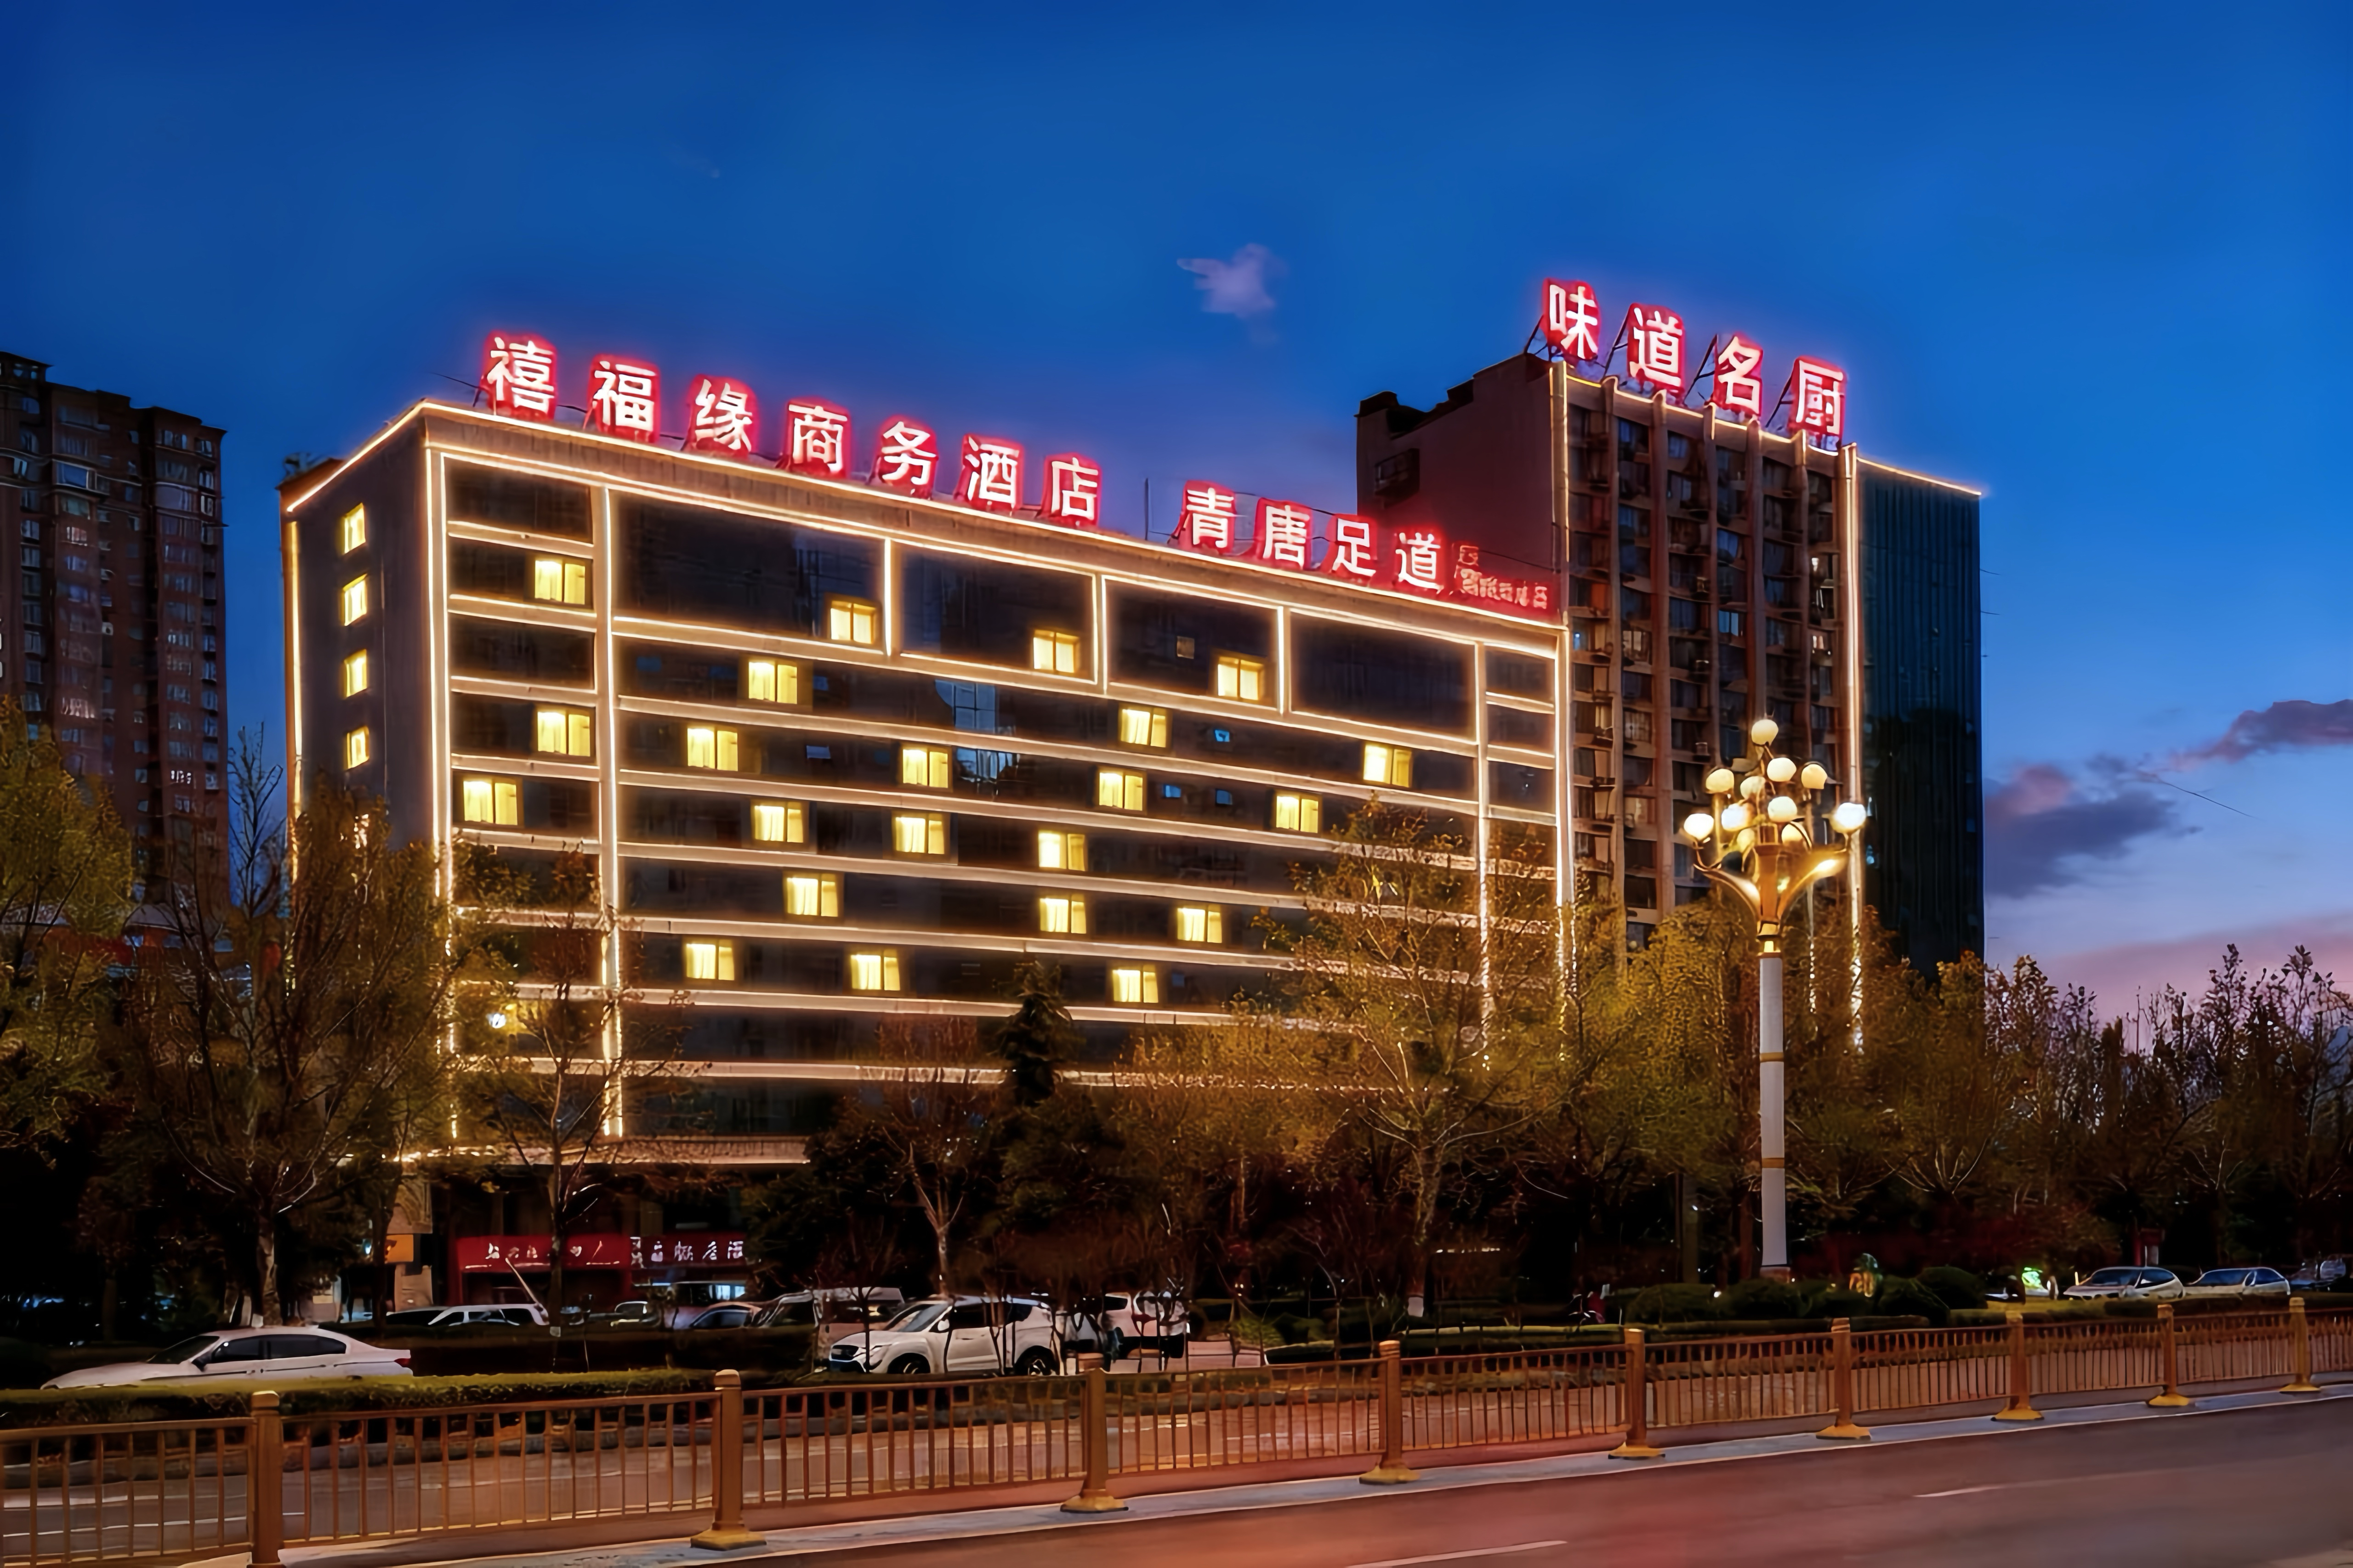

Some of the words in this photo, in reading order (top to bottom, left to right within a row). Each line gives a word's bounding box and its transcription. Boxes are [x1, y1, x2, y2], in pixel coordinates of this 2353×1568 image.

[487, 337, 1099, 521] 禧福缘商务酒店
[1549, 284, 1844, 436] 味道名厨
[1186, 487, 1441, 593] 青唐足道
